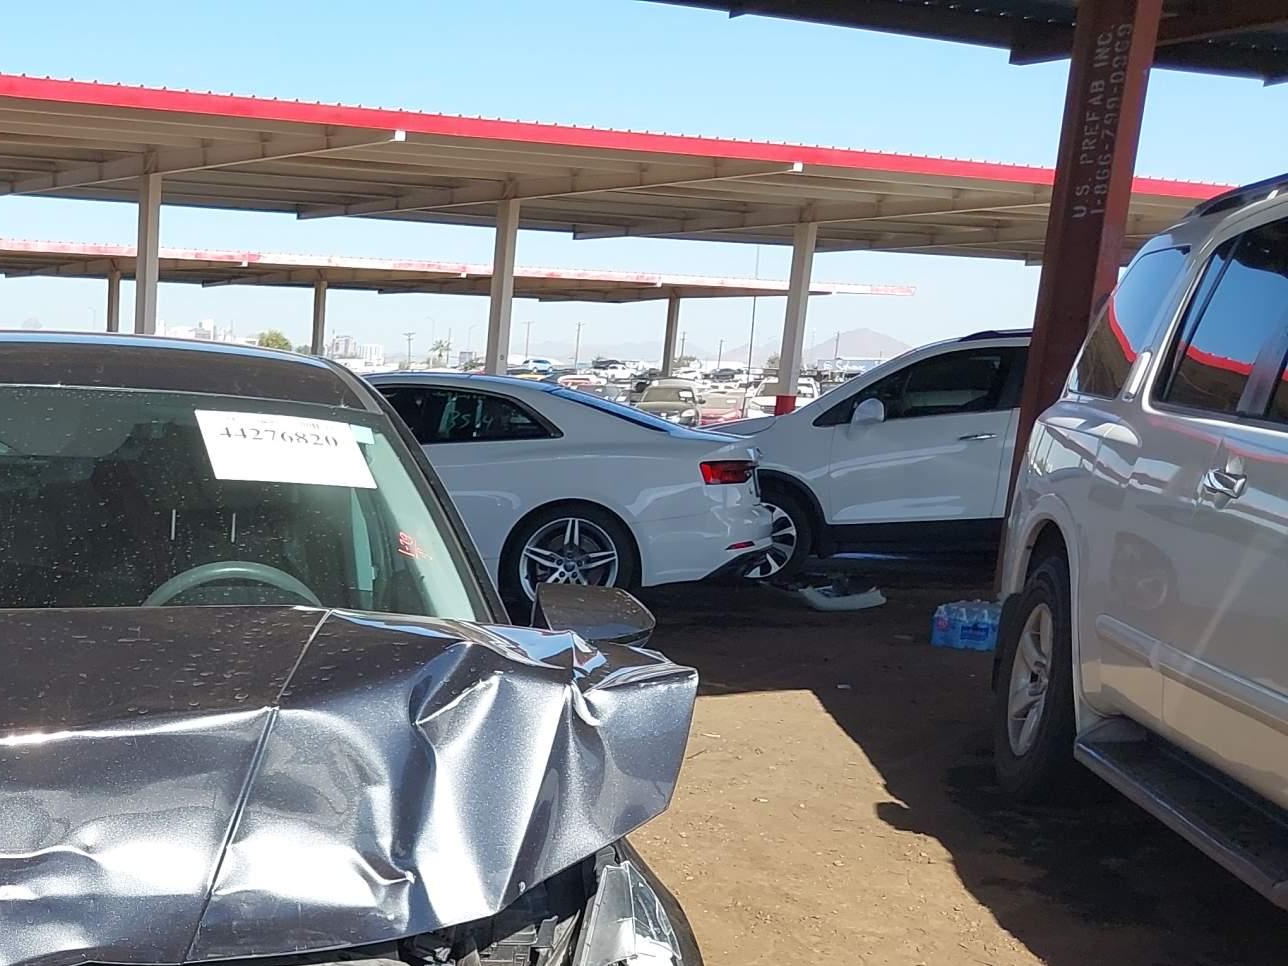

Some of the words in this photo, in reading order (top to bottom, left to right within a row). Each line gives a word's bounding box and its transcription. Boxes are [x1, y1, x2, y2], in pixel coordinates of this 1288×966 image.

[1093, 24, 1114, 68] INC.
[1080, 80, 1105, 164] PREFAB
[1072, 178, 1092, 218] U.S.
[219, 426, 338, 447] 44276820
